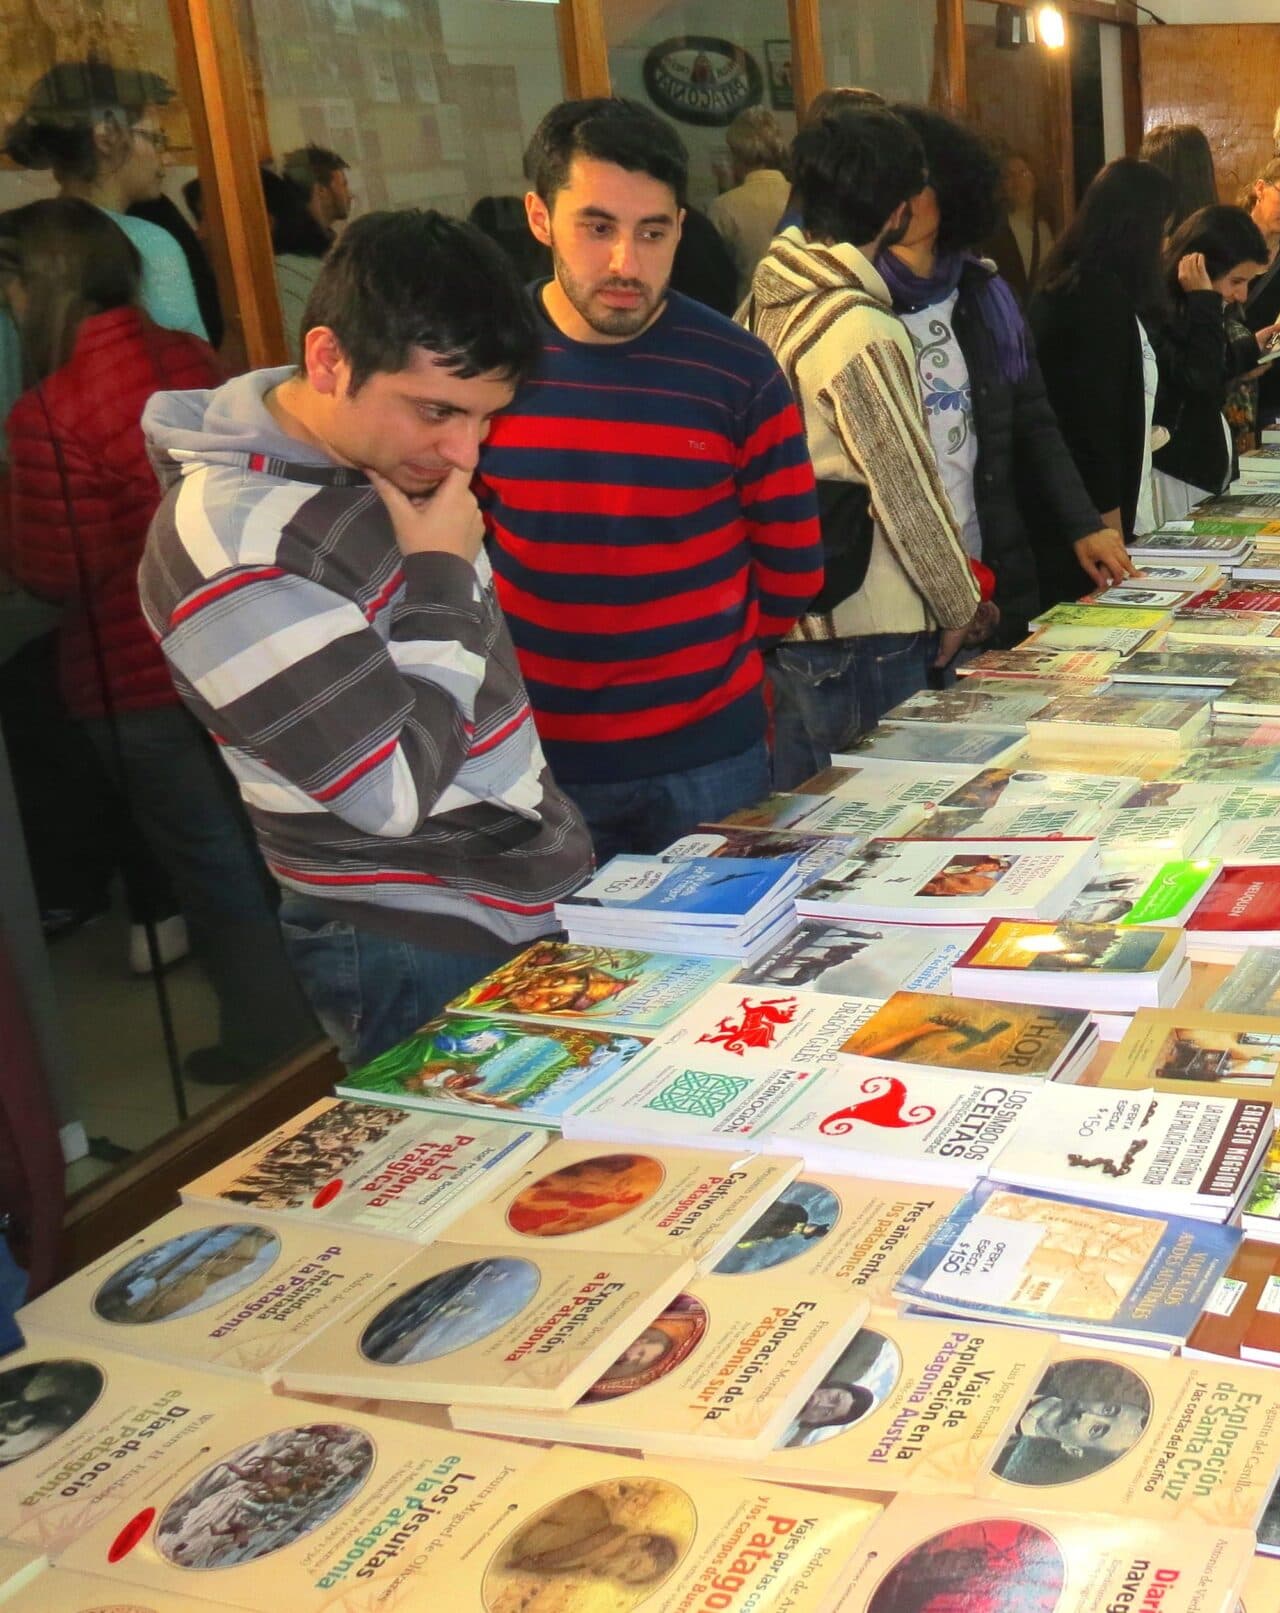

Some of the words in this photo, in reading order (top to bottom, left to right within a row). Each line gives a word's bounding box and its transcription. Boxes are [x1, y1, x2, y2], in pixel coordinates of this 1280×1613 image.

[1002, 1014, 1060, 1067] THOR
[722, 1072, 795, 1132] MABINOGION
[1001, 1090, 1031, 1109] LOS
[1120, 1103, 1140, 1128] OFERTA
[937, 1088, 1009, 1157] CELTAS
[1227, 1105, 1267, 1143] ERNESTO
[361, 1141, 441, 1195] trágica
[368, 1135, 473, 1209] Patagonia
[425, 1163, 457, 1182] La
[1207, 1147, 1250, 1192] MAGGIORI
[652, 1175, 725, 1229] Patagonia
[693, 1171, 750, 1211] Cautivo
[677, 1211, 702, 1226] en
[884, 1200, 911, 1219] los
[899, 1198, 935, 1224] Tres
[665, 1225, 691, 1238] la
[874, 1223, 913, 1254] años
[314, 1244, 344, 1263] de
[831, 1220, 891, 1280] patagones
[957, 1240, 992, 1275] ESPECIAL
[977, 1242, 1008, 1272] OFERTA
[296, 1260, 322, 1277] la
[318, 1271, 345, 1288] La
[592, 1270, 610, 1282] a
[848, 1252, 890, 1288] entre
[256, 1269, 329, 1320] encantada
[271, 1285, 325, 1322] ciudad
[577, 1279, 604, 1297] la
[207, 1275, 304, 1337] Patagonia
[534, 1281, 623, 1354] Expedición
[500, 1296, 586, 1361] Patagonia
[715, 1305, 788, 1378] Patagonia
[733, 1300, 816, 1385] Exploración
[901, 1330, 971, 1404] Patagonia
[913, 1336, 990, 1421] exploración
[1193, 1379, 1208, 1389] y
[153, 1388, 184, 1408] en
[696, 1377, 725, 1403] sur
[719, 1385, 745, 1405] de
[950, 1366, 996, 1407] Viaje
[1186, 1386, 1206, 1403] las
[1210, 1381, 1237, 1403] de
[131, 1406, 159, 1426] la
[136, 1403, 190, 1440] Días
[702, 1403, 730, 1424] la
[939, 1409, 970, 1429] de
[1171, 1402, 1198, 1433] costas
[1182, 1402, 1229, 1455] Santa
[105, 1438, 145, 1461] de
[864, 1408, 921, 1464] Austral
[903, 1423, 929, 1443] en
[1164, 1433, 1183, 1451] del
[1185, 1390, 1262, 1496] Exploración
[16, 1425, 136, 1506] Patagonia
[430, 1453, 463, 1475] en
[893, 1444, 922, 1462] la
[57, 1461, 115, 1497] ocio
[411, 1476, 441, 1495] la
[1140, 1450, 1176, 1492] Pacífico
[1158, 1456, 1201, 1501] Cruz
[426, 1472, 476, 1508] Los
[740, 1502, 766, 1521] los
[312, 1495, 422, 1590] Patagonia
[351, 1504, 442, 1580] jesuitas
[702, 1520, 753, 1565] campos
[778, 1515, 820, 1550] Viajes
[695, 1566, 721, 1582] de
[761, 1551, 792, 1570] por
[754, 1573, 779, 1589] las
